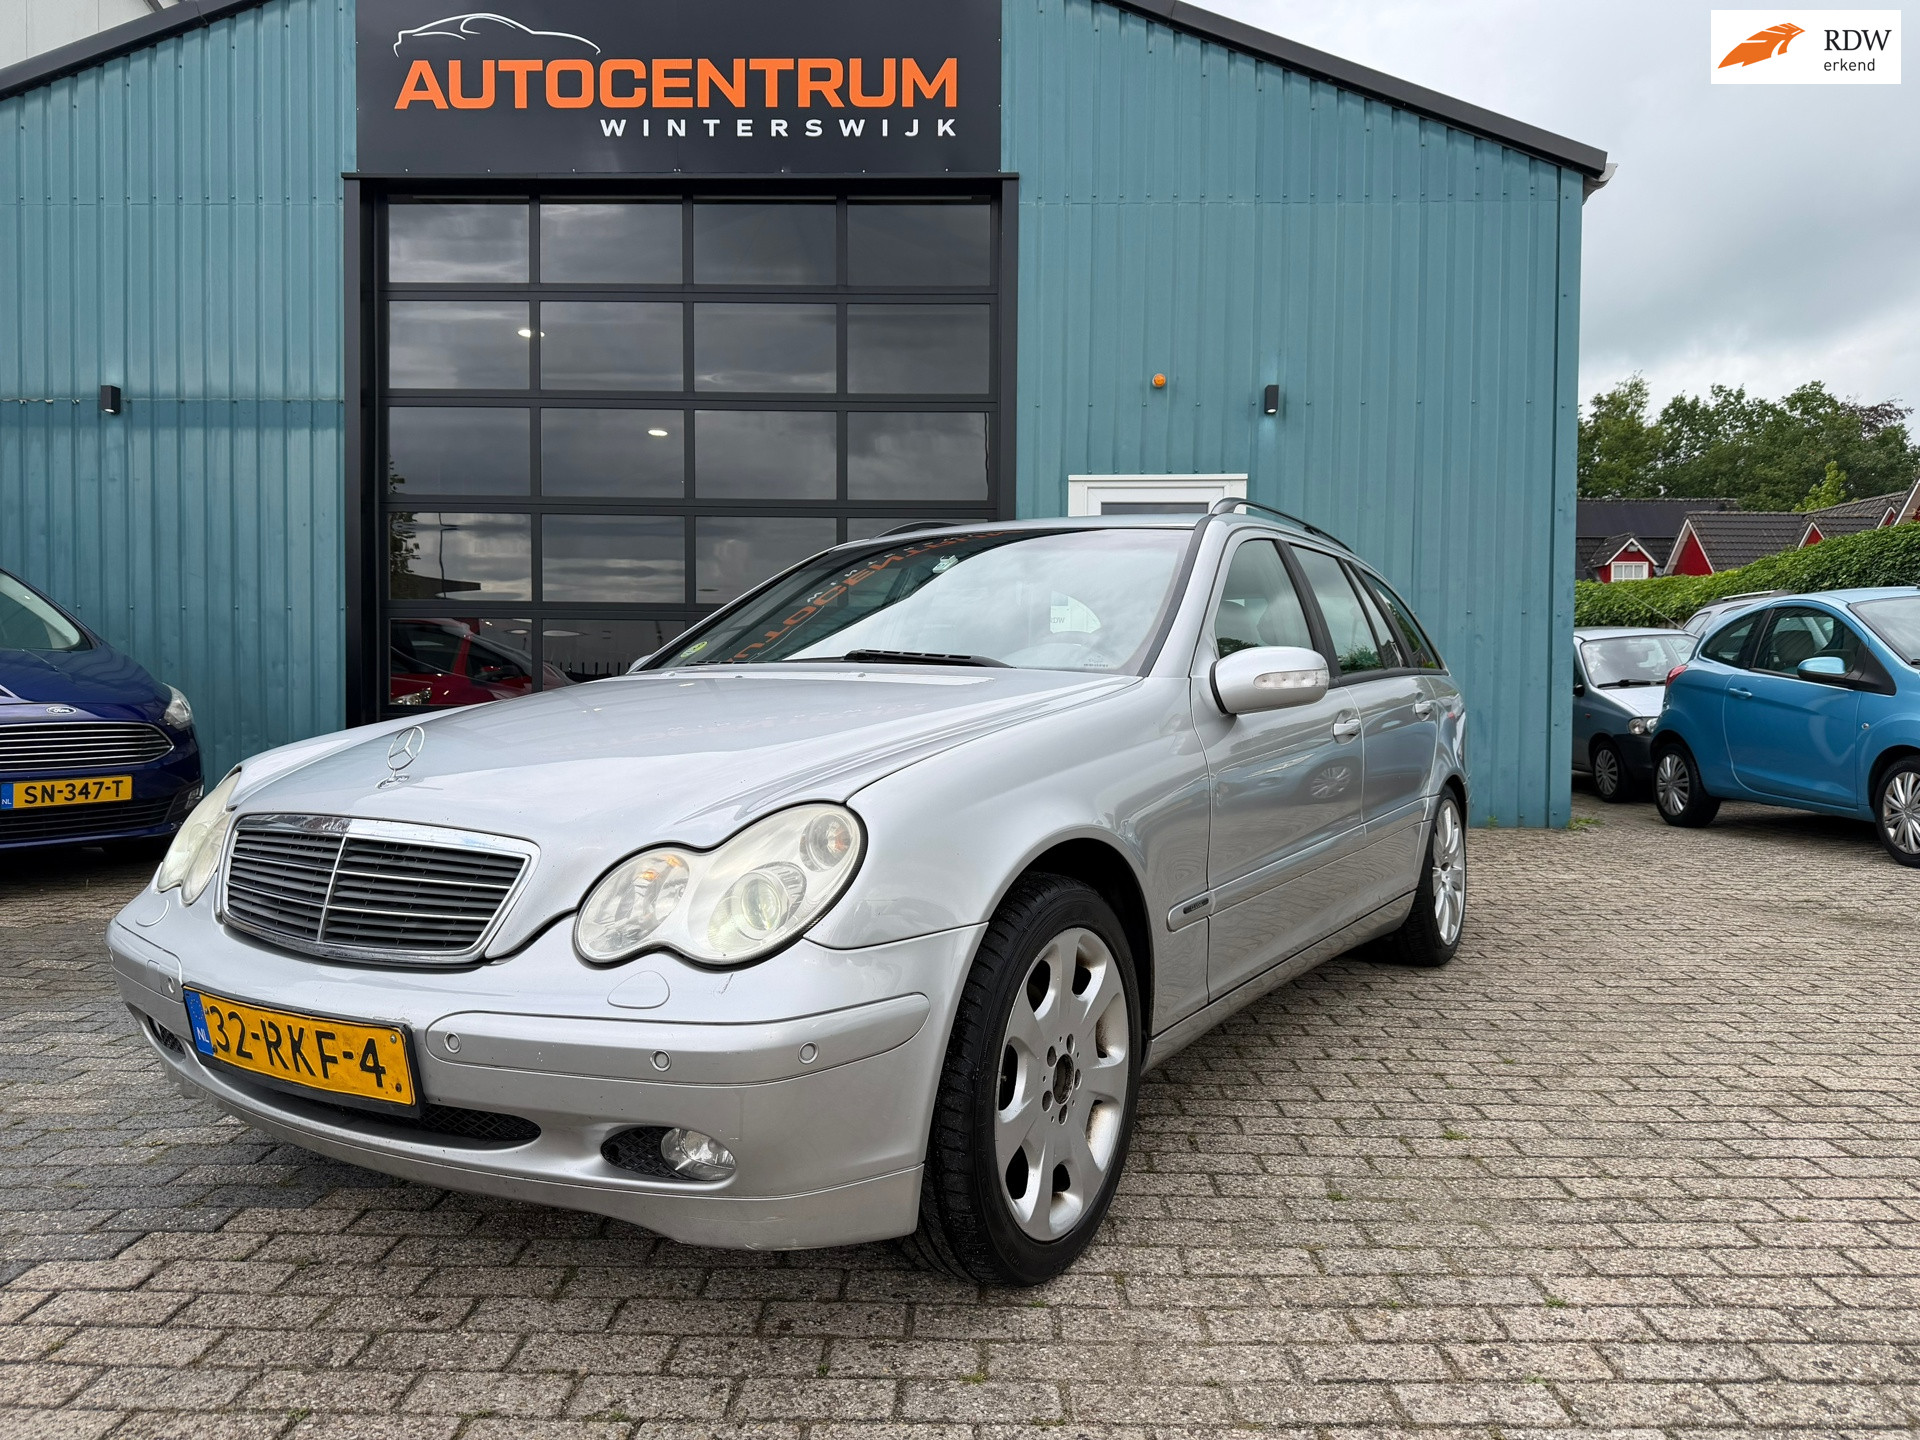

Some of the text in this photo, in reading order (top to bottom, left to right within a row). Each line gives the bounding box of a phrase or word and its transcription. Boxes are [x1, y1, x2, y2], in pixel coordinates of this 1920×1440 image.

[394, 57, 958, 110] AUTOCENTRUM
[600, 118, 958, 137] WINTERSWIJK
[24, 780, 124, 804] SN-347-T
[196, 1026, 210, 1043] NL
[208, 1005, 386, 1088] 32-RKF-4
